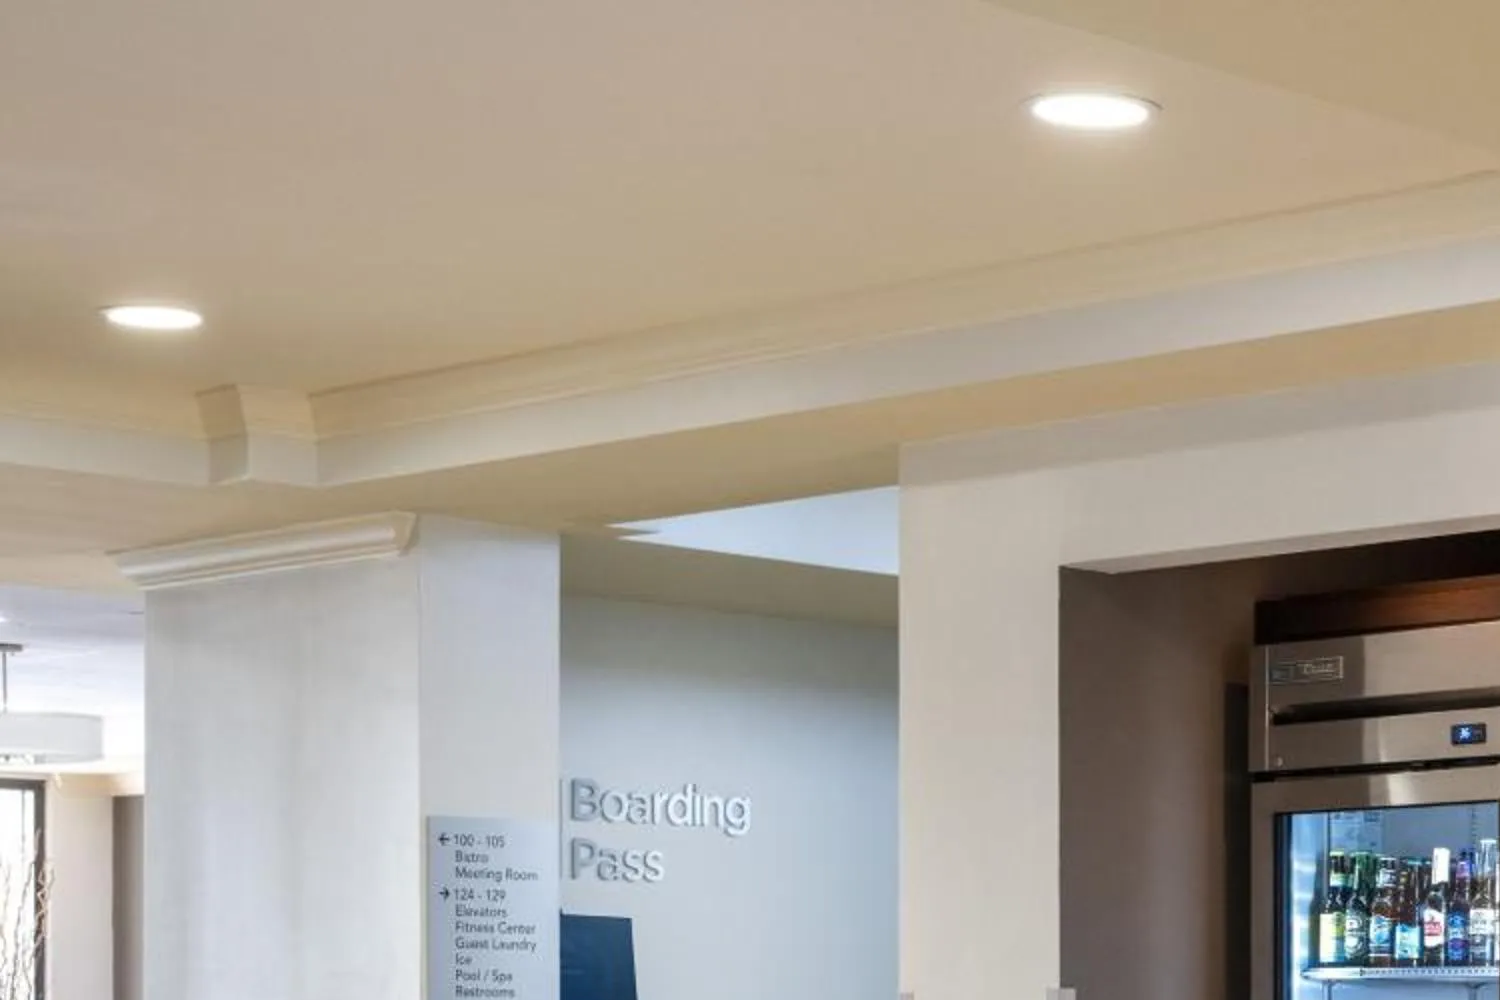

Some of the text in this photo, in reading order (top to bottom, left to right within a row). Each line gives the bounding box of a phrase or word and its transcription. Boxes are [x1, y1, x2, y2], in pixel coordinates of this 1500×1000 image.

[569, 777, 752, 836] Boarding
[454, 834, 475, 847] 100
[486, 835, 505, 848] 105
[455, 851, 489, 863] Bistro
[569, 837, 665, 882] Pass
[455, 867, 539, 882] Meeting Room
[455, 888, 474, 901] 124
[486, 889, 506, 902] 129
[455, 905, 508, 917] Elevators
[455, 922, 536, 935] Fitness Center
[455, 938, 537, 953] Guest Laundry
[455, 953, 472, 965] Ice
[455, 969, 481, 981] Pool
[491, 970, 513, 984] Spa
[455, 986, 515, 998] Restrooms
